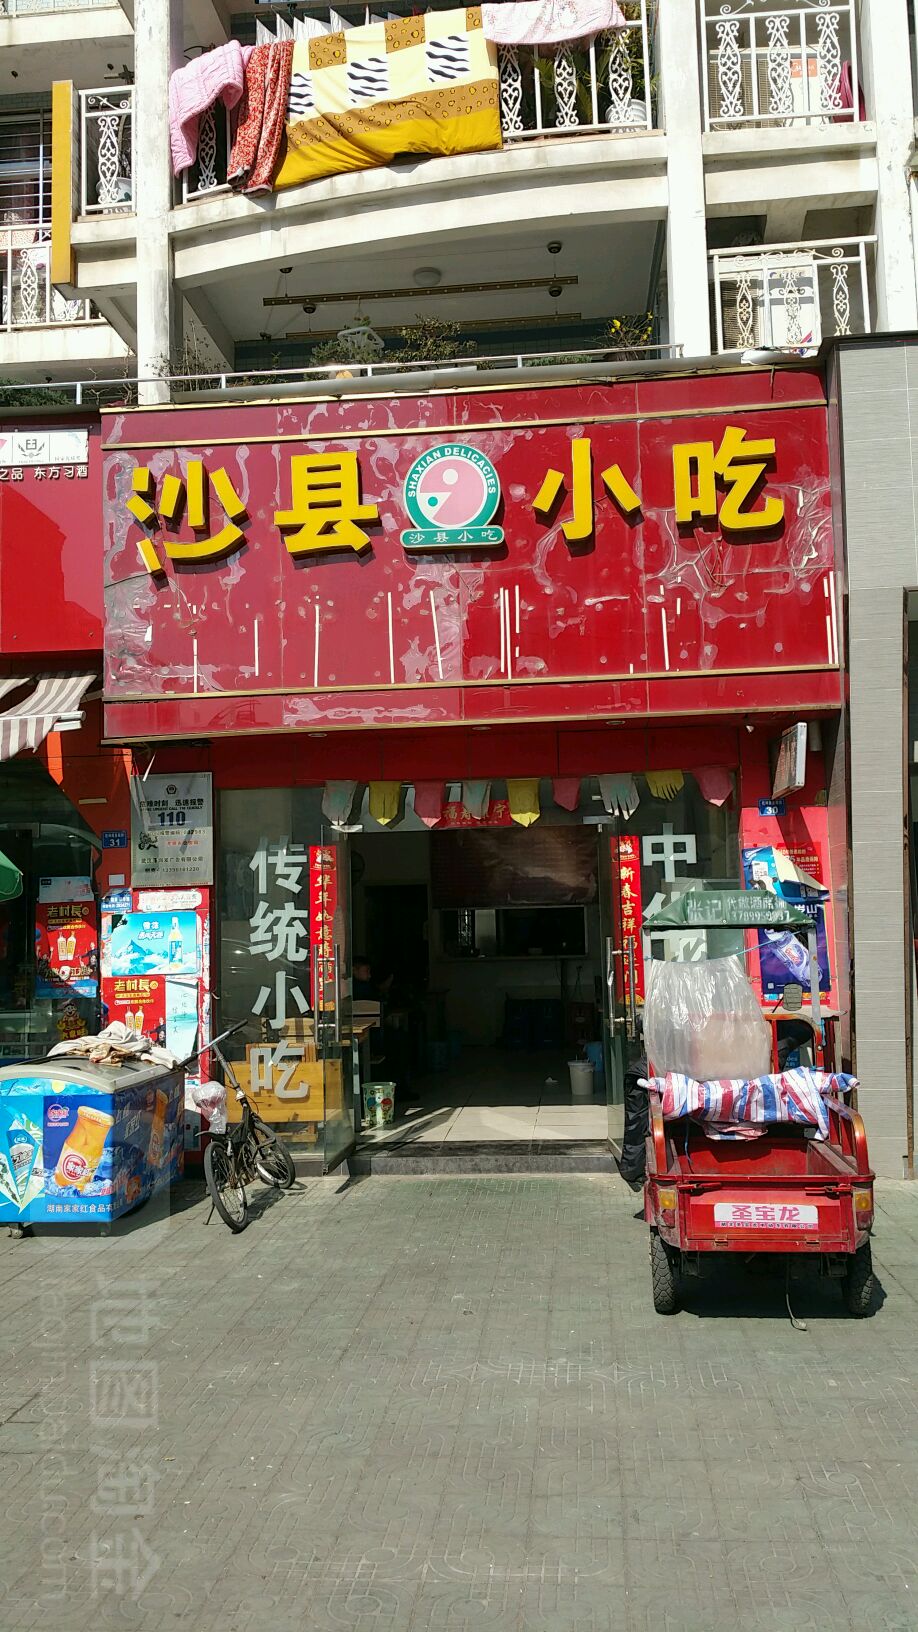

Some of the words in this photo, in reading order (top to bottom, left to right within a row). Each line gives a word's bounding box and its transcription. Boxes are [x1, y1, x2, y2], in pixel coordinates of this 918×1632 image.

[34, 465, 88, 480] 东方习酒
[408, 450, 441, 497] SHAXIAN
[444, 448, 496, 494] DELICACIES
[126, 451, 378, 573] 沙县
[532, 426, 784, 541] 小吃
[409, 529, 498, 544] 沙县小吃
[766, 806, 778, 815] 30
[158, 811, 186, 827] 110
[109, 838, 121, 848] 31
[248, 835, 309, 1099] 传统小吃
[732, 1204, 801, 1222] 圣宝龙
